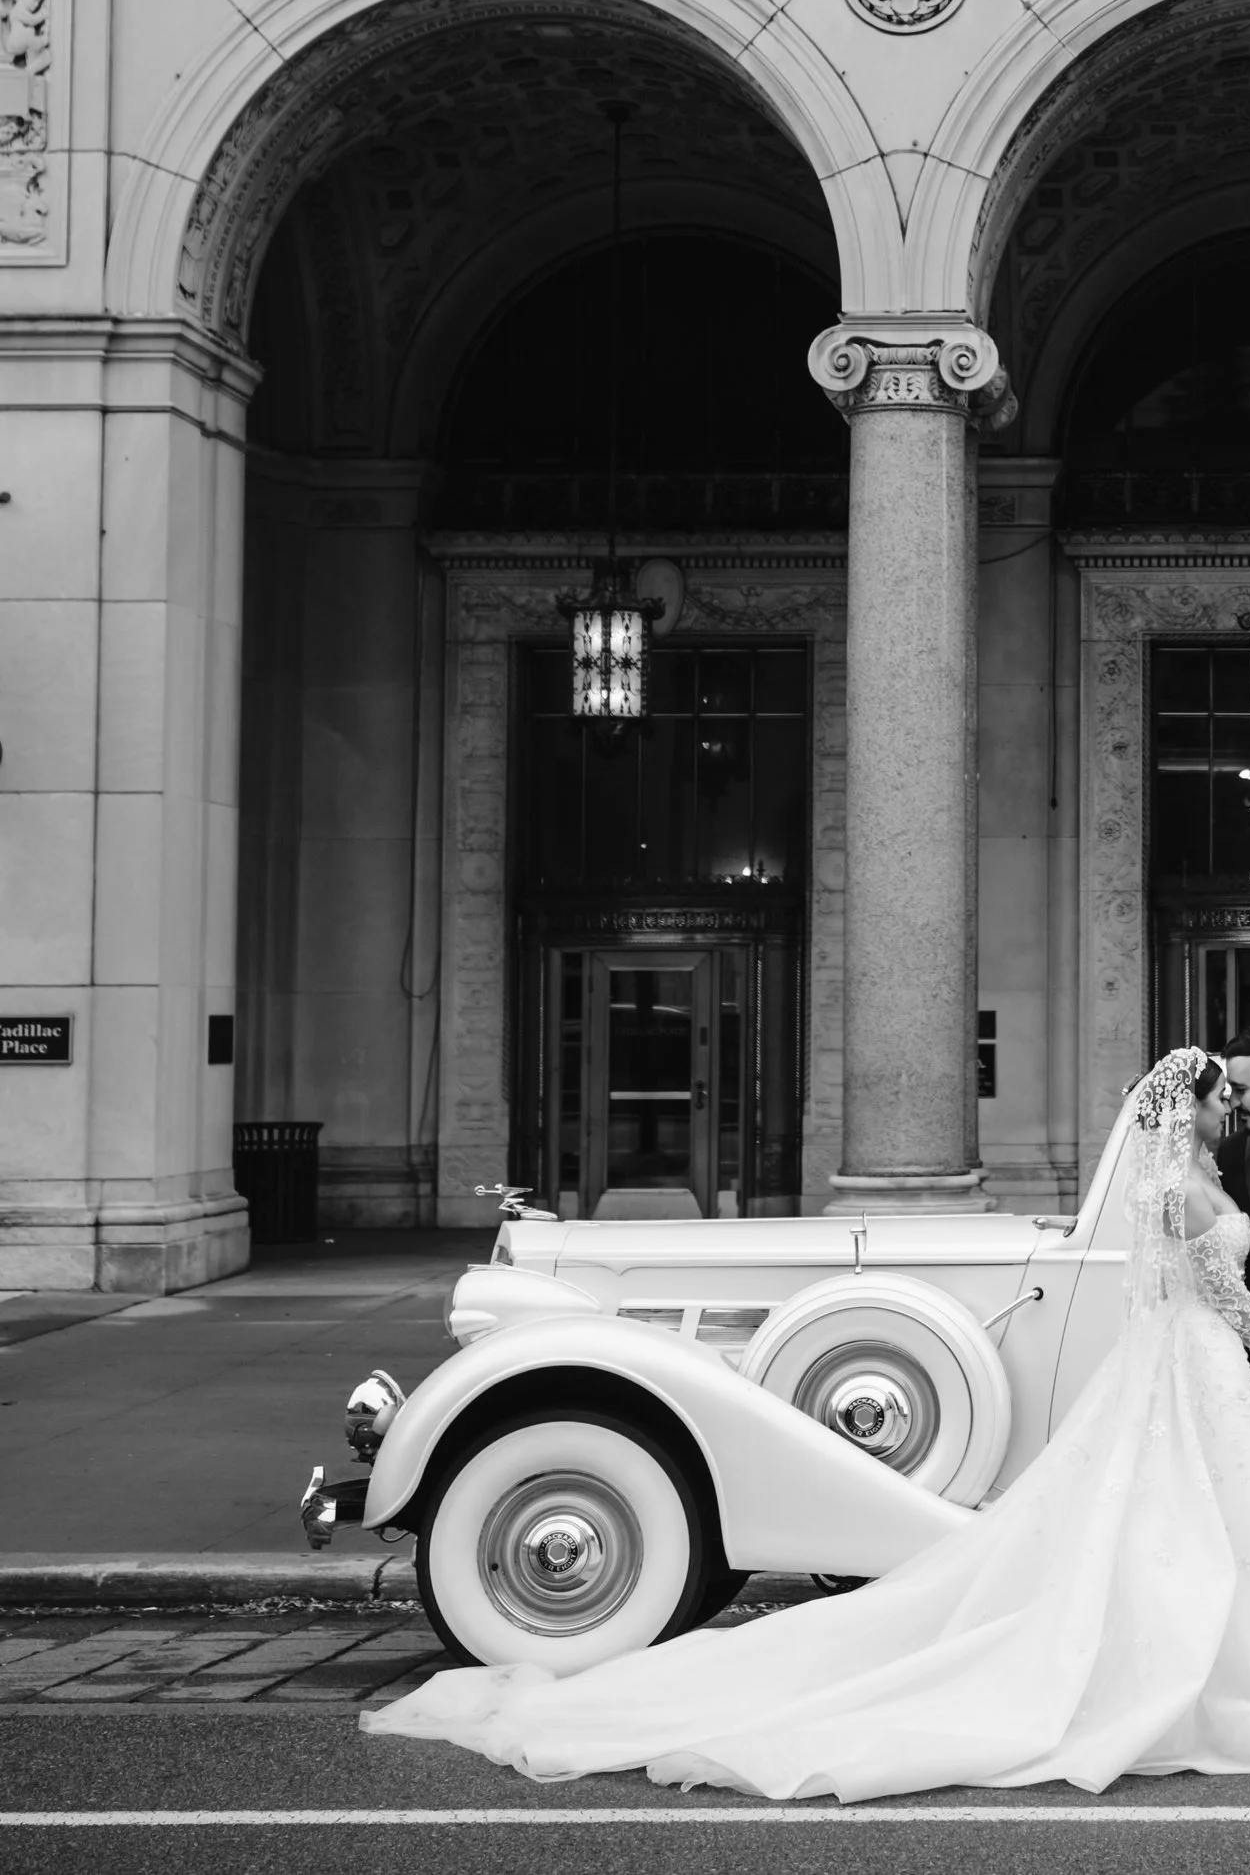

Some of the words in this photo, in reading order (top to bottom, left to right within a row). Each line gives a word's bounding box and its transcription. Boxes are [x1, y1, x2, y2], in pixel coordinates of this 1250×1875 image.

[0, 1024, 61, 1037] adillac
[2, 1040, 48, 1054] Place
[848, 1399, 882, 1412] PACKARD
[542, 1533, 576, 1549] PACKARD
